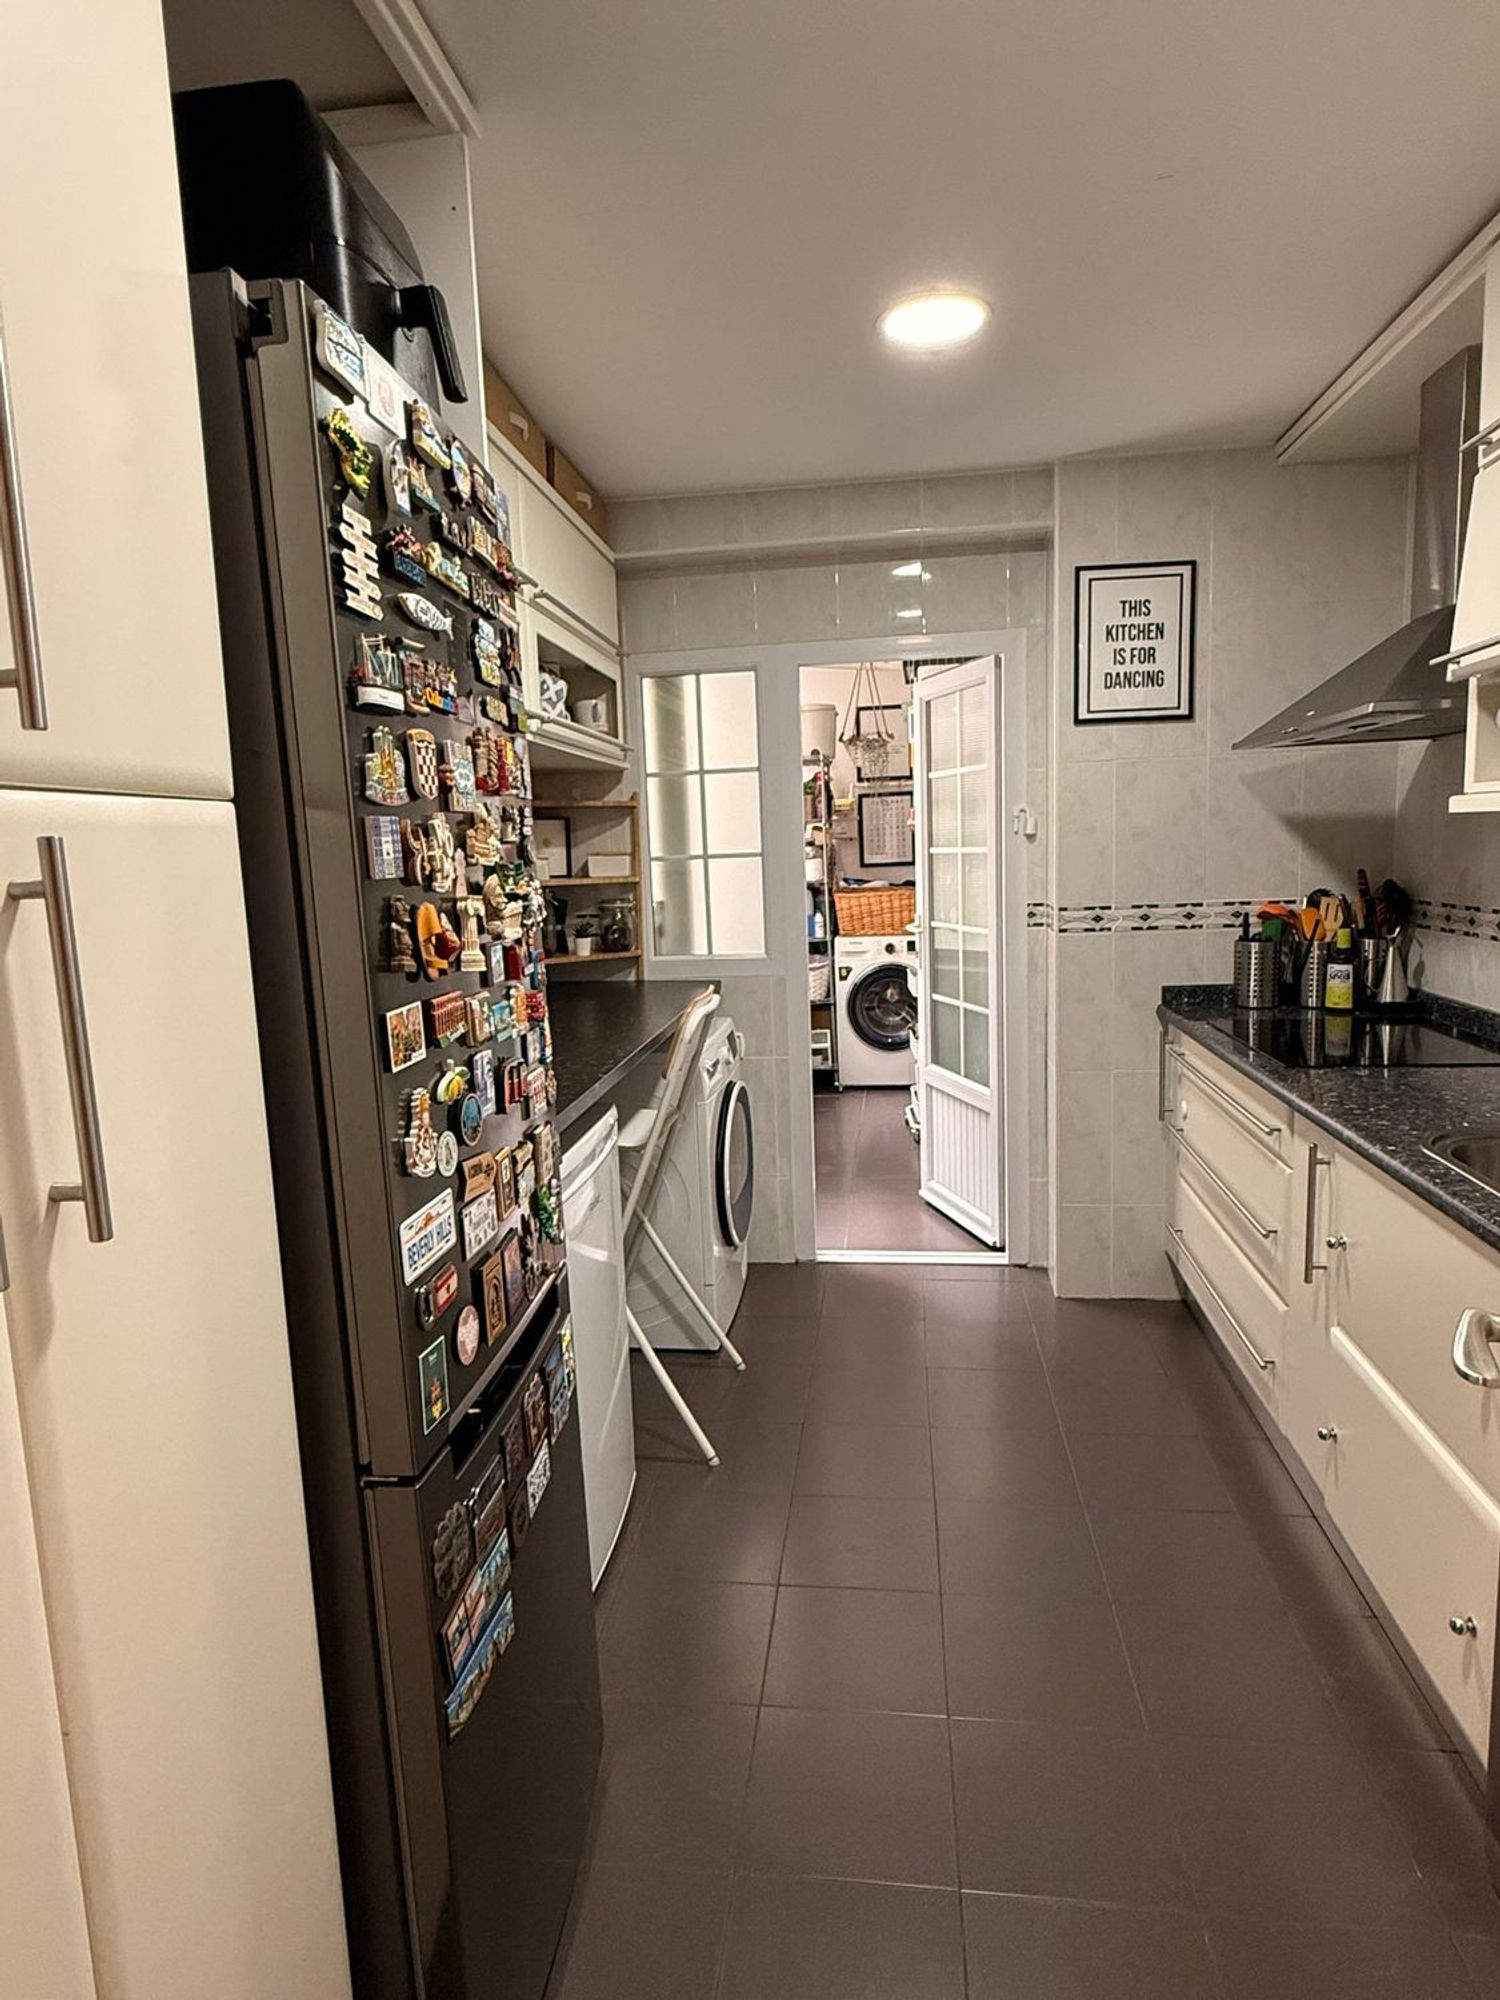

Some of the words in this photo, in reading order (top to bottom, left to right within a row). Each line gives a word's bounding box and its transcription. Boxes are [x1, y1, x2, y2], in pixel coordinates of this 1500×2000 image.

[1119, 599, 1151, 617] THIS
[1105, 622, 1164, 642] KITCHEN
[1112, 648, 1126, 665] IS
[1129, 647, 1156, 664] FOR
[1103, 670, 1164, 689] DANCING
